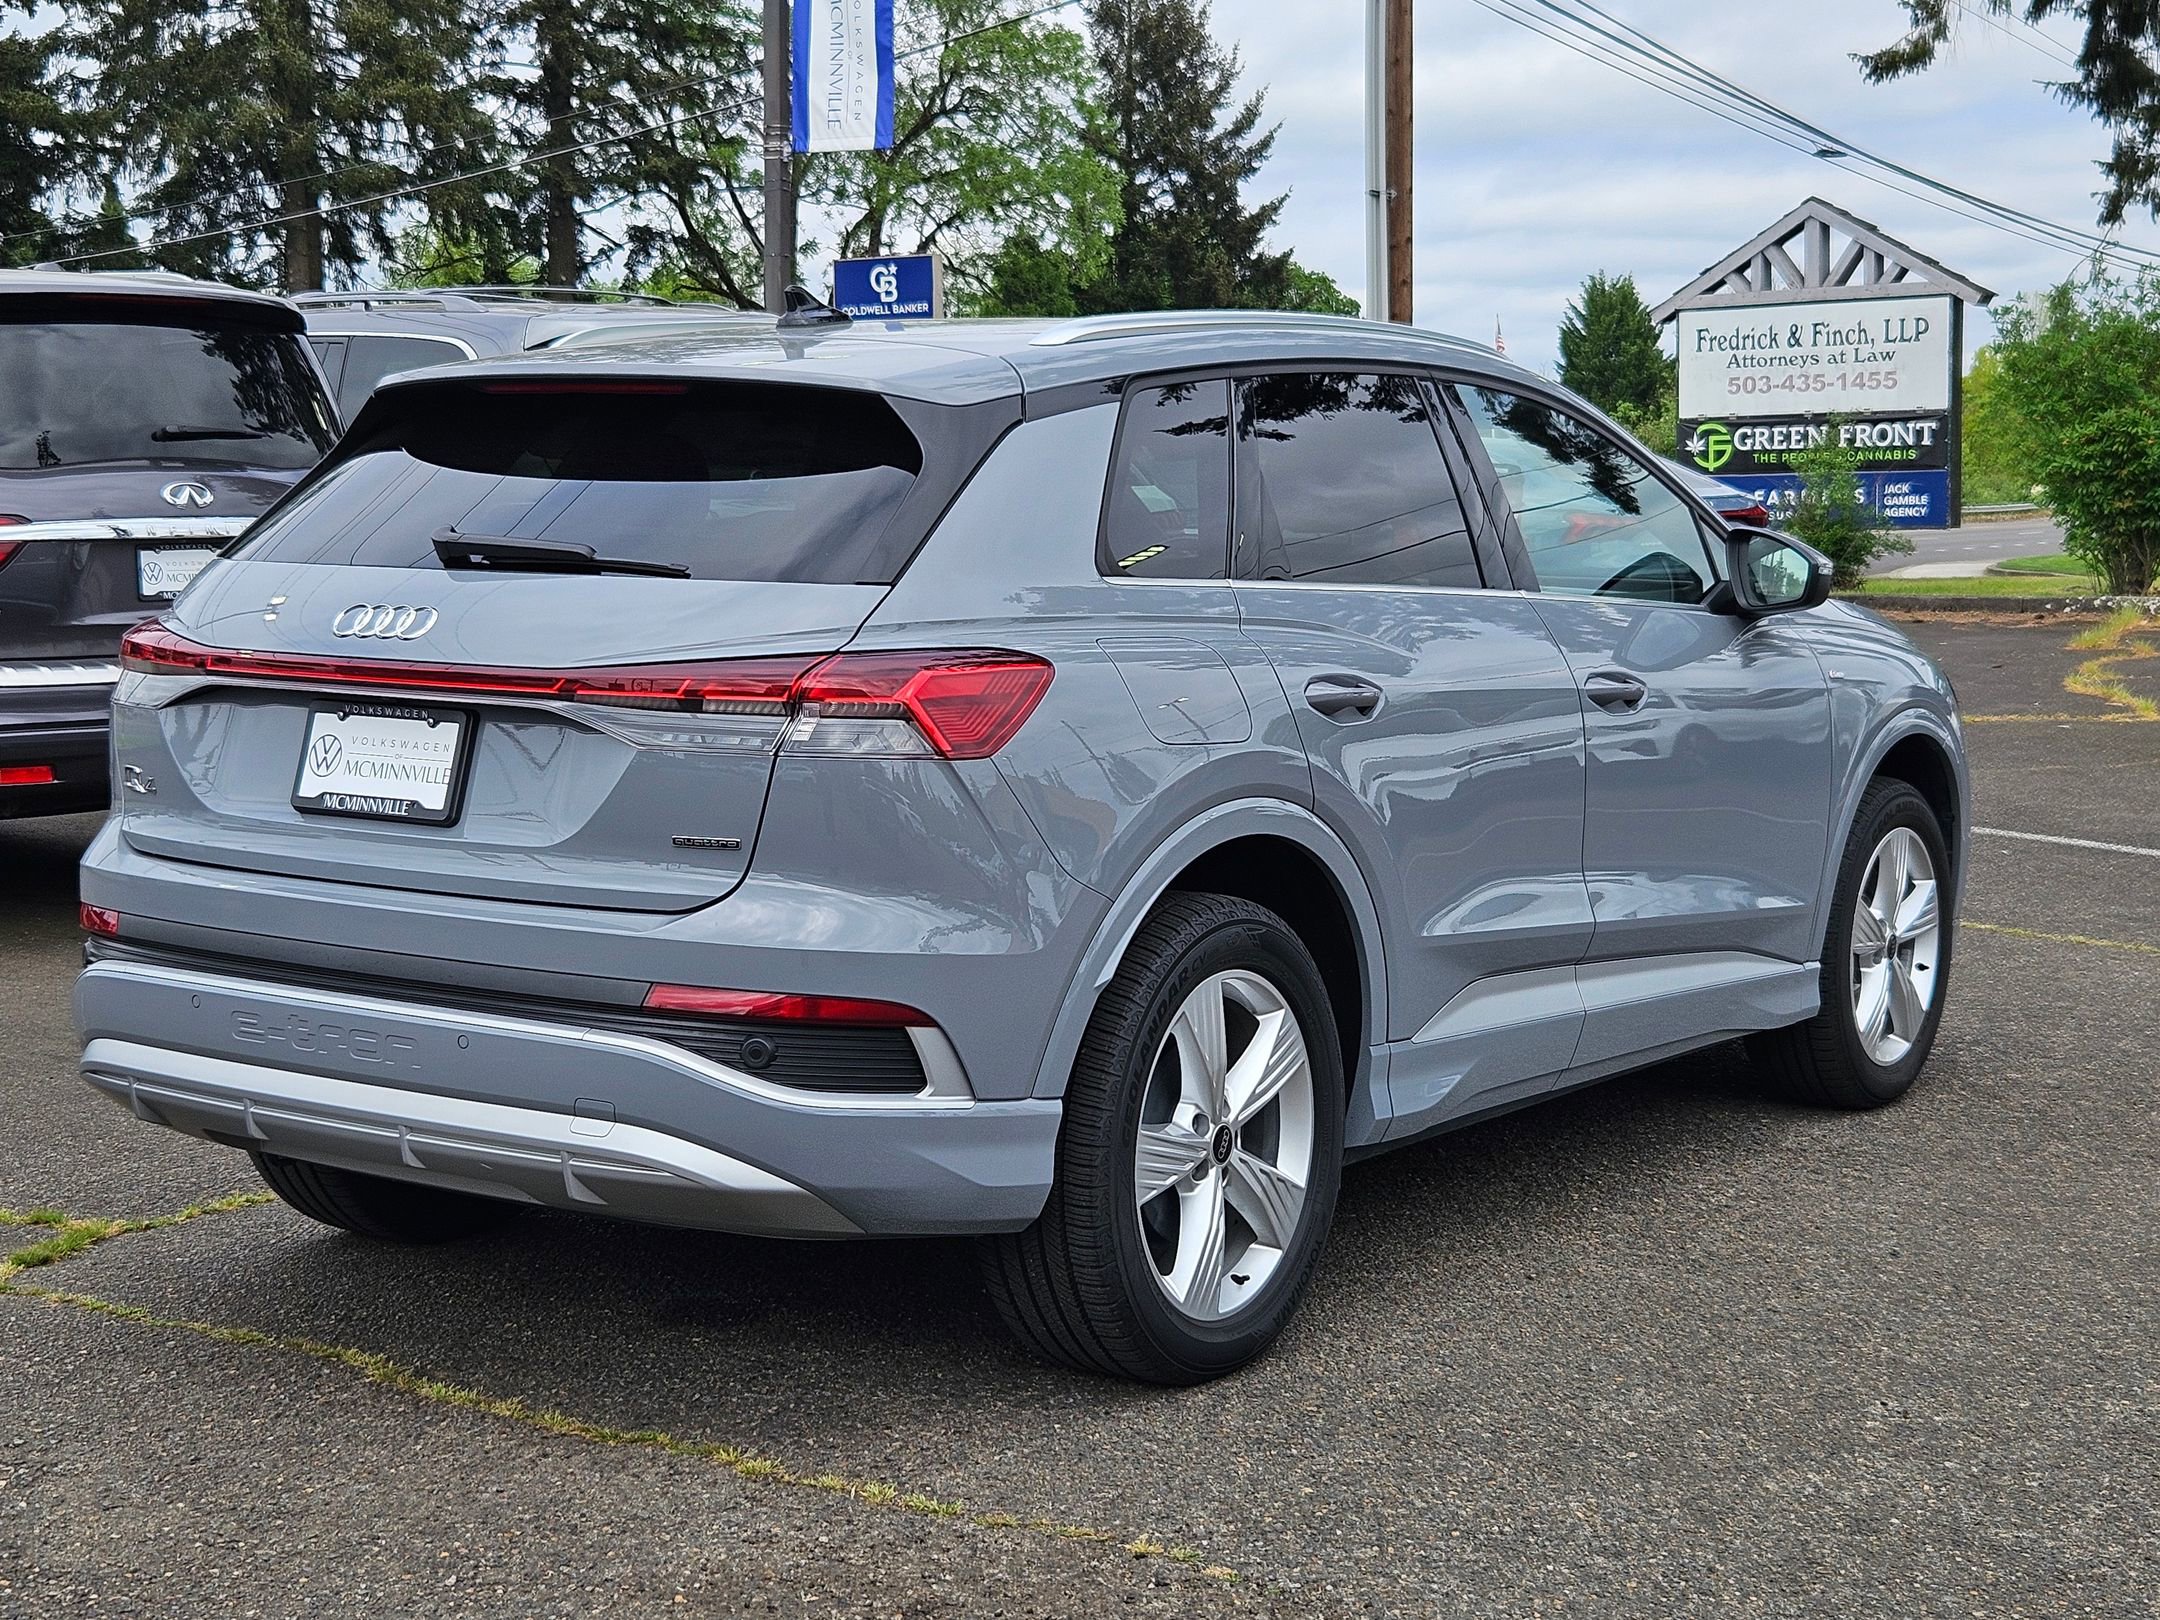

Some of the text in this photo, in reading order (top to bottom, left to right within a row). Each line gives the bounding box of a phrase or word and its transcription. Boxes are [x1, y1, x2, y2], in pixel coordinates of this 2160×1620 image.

[827, 0, 844, 130] CMINNVILLE
[854, 0, 864, 121] OLKSWAGEN
[892, 303, 929, 314] BANKER
[1695, 317, 1930, 353] Fredrick & Finch, LLP
[1726, 347, 1897, 369] Attorneys at Law
[1727, 370, 1898, 396] 503-435-1455
[1733, 421, 1937, 451] GREEN FRONT
[1753, 453, 1777, 464] THE
[1847, 450, 1917, 462] CANNABIS
[1884, 483, 1909, 494] JACK
[1884, 494, 1928, 505] GAMBLE
[1883, 506, 1927, 517] AGENCY
[345, 705, 429, 719] VOLKSWAGEN
[352, 736, 450, 753] VOLKSWAGEN
[343, 760, 452, 785] MCMINNVILLE
[324, 794, 411, 816] MCMINNVILLE
[675, 838, 737, 848] quattro
[231, 1010, 421, 1069] e-tron
